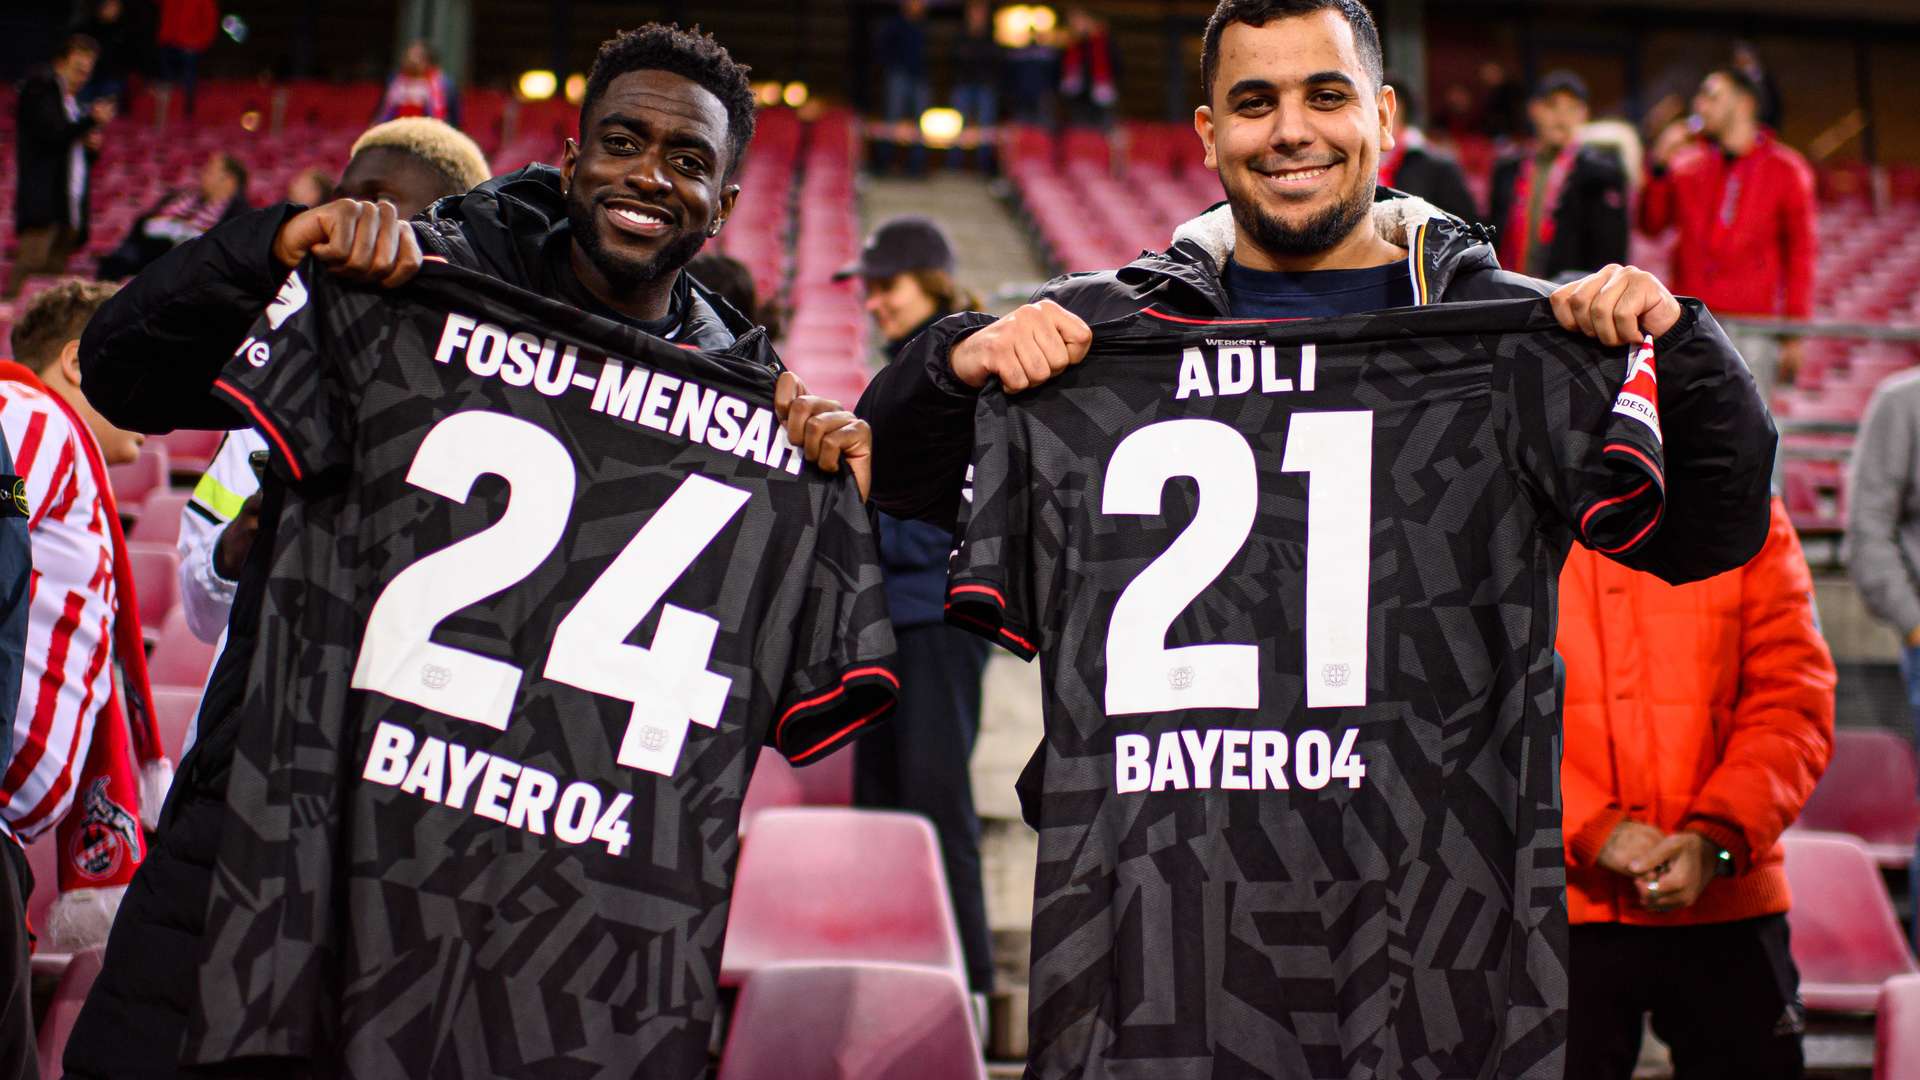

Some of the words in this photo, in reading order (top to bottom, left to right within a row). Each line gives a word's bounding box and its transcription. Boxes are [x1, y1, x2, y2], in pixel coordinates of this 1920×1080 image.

[1175, 344, 1316, 399] ADLI
[351, 410, 752, 777] 24
[1101, 410, 1374, 716] 21
